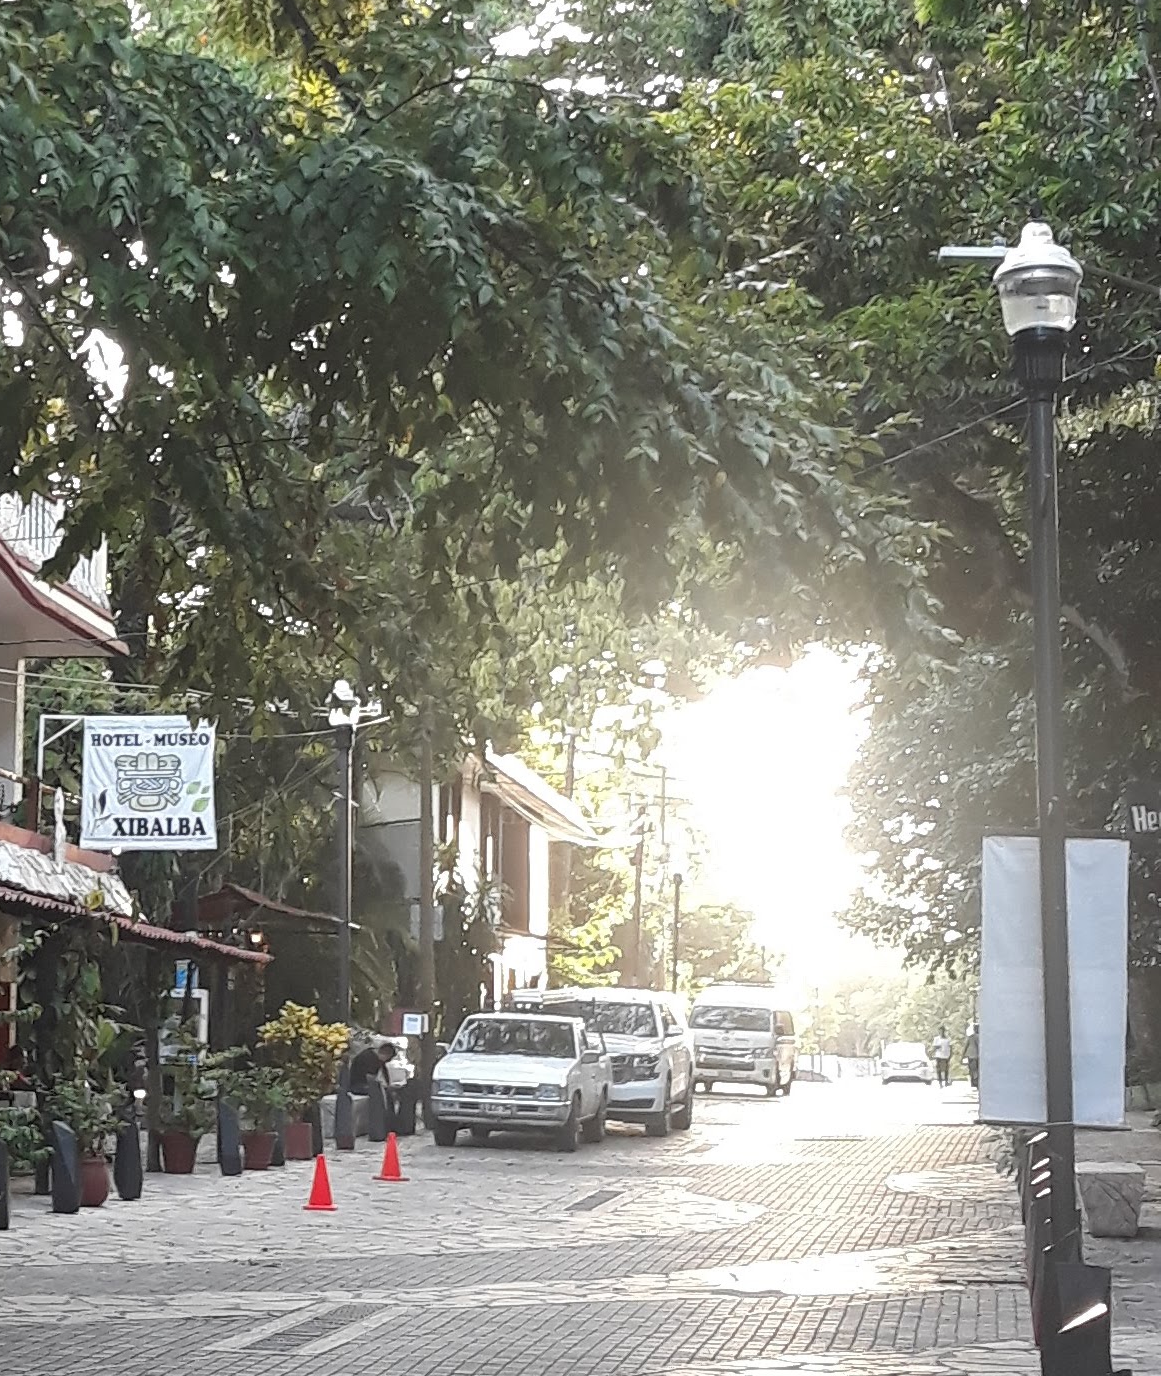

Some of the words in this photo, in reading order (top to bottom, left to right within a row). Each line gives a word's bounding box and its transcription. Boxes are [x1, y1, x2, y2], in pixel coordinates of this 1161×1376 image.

[91, 733, 141, 747] HOTEL
[153, 732, 210, 747] MUSEO
[112, 817, 207, 837] XIBALBA
[1131, 805, 1161, 833] He
